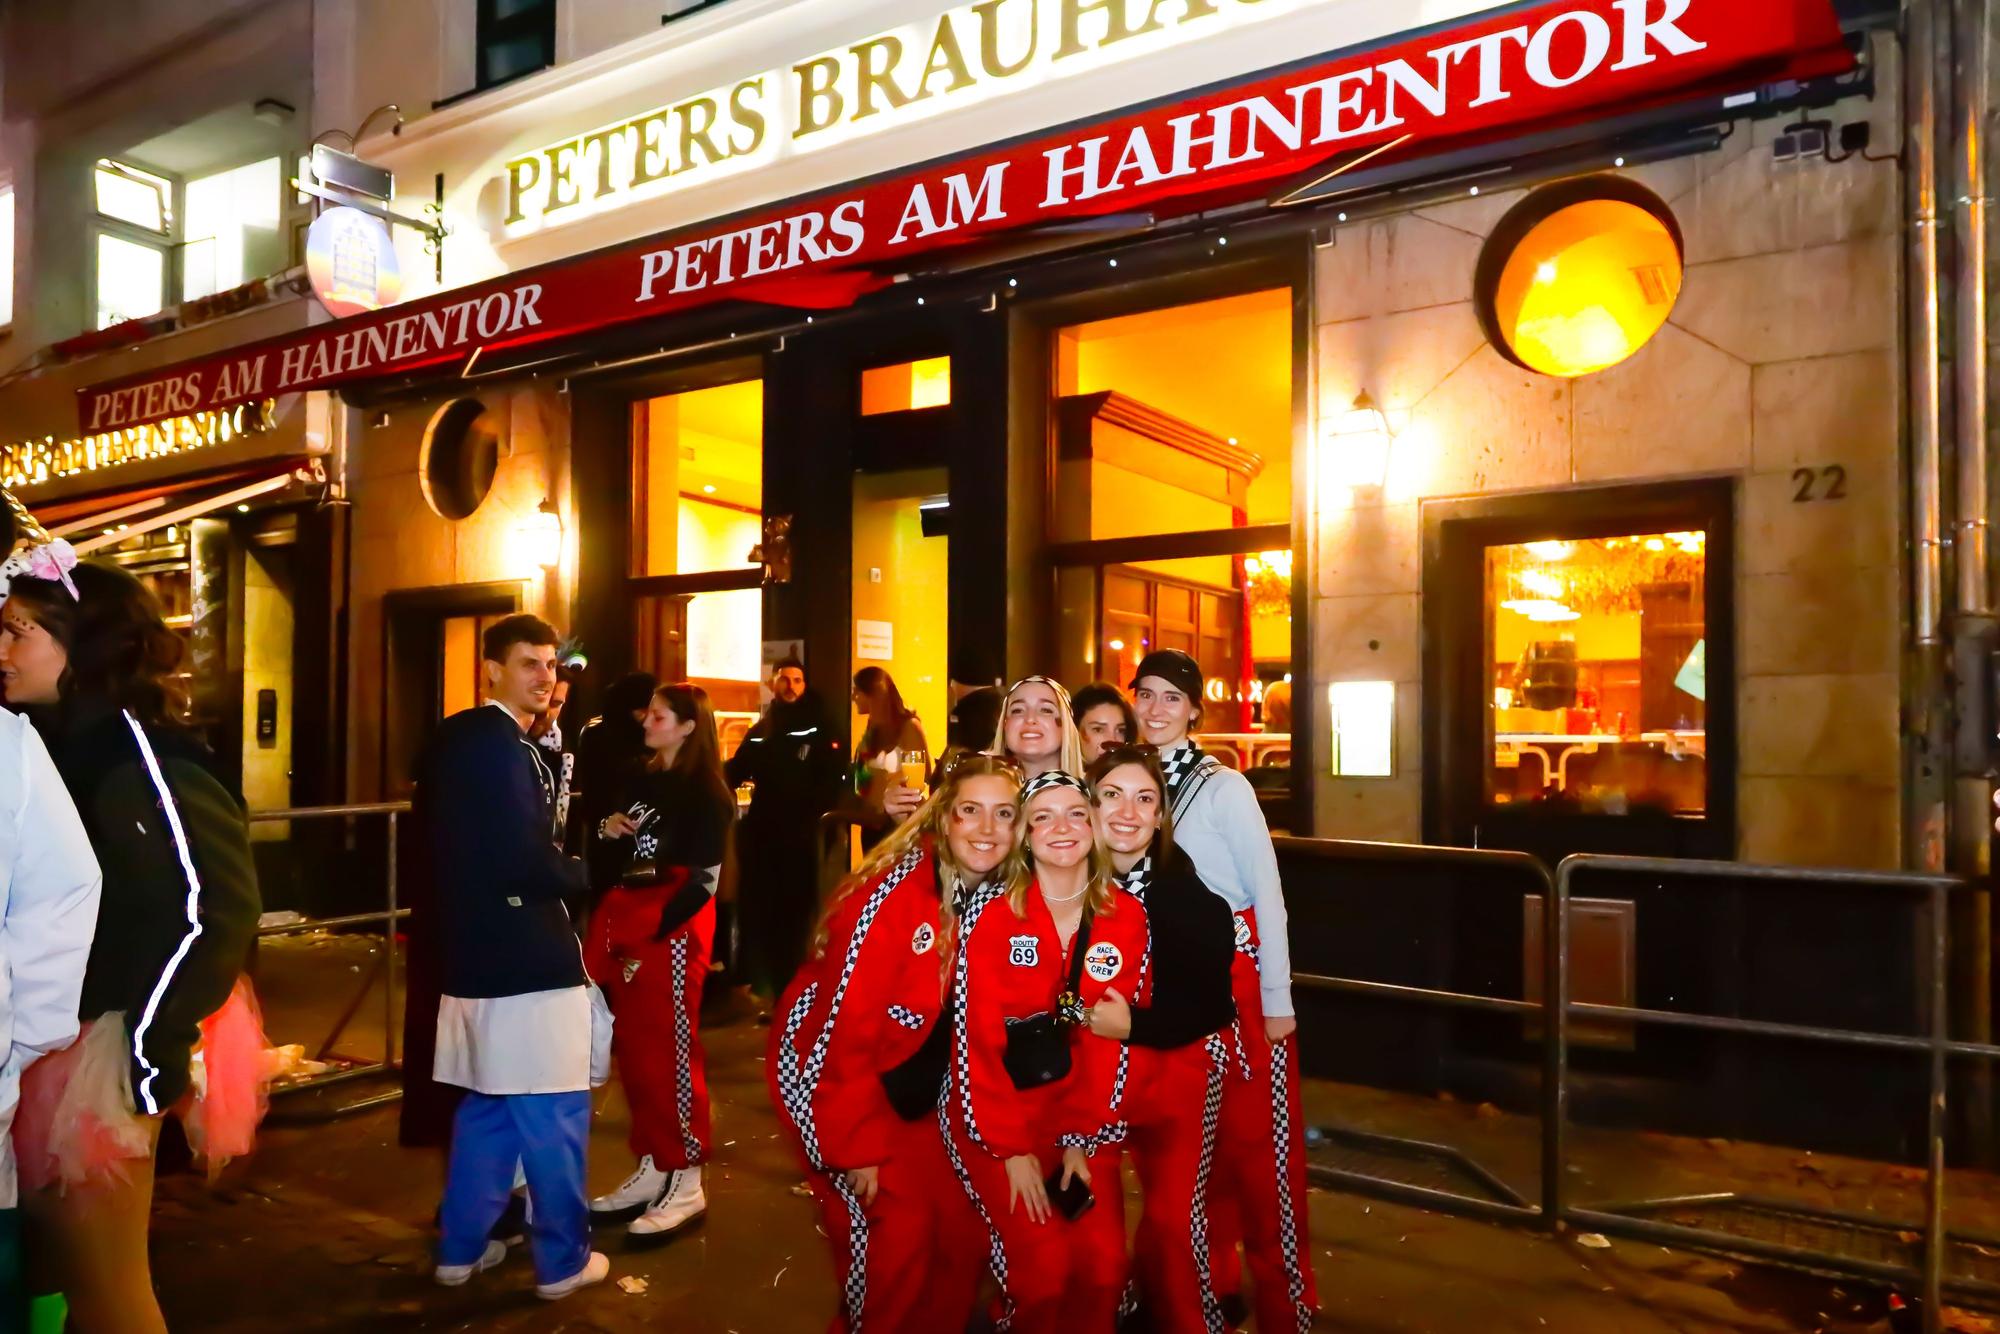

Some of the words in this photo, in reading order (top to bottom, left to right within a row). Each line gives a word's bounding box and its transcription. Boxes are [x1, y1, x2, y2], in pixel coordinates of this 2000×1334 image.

[504, 77, 765, 226] PETERS
[792, 0, 1281, 139] BRAUH
[635, 200, 864, 302] PETERS
[888, 161, 1010, 245] AM
[1038, 0, 1707, 208] HAHNENTOR
[89, 372, 202, 429] PETERS
[210, 354, 267, 404] AM
[277, 283, 543, 389] HAHNENTOR
[1792, 465, 1846, 502] 22
[1012, 948, 1035, 964] 69
[1096, 946, 1113, 954] RACE
[1090, 964, 1113, 976] CREW
